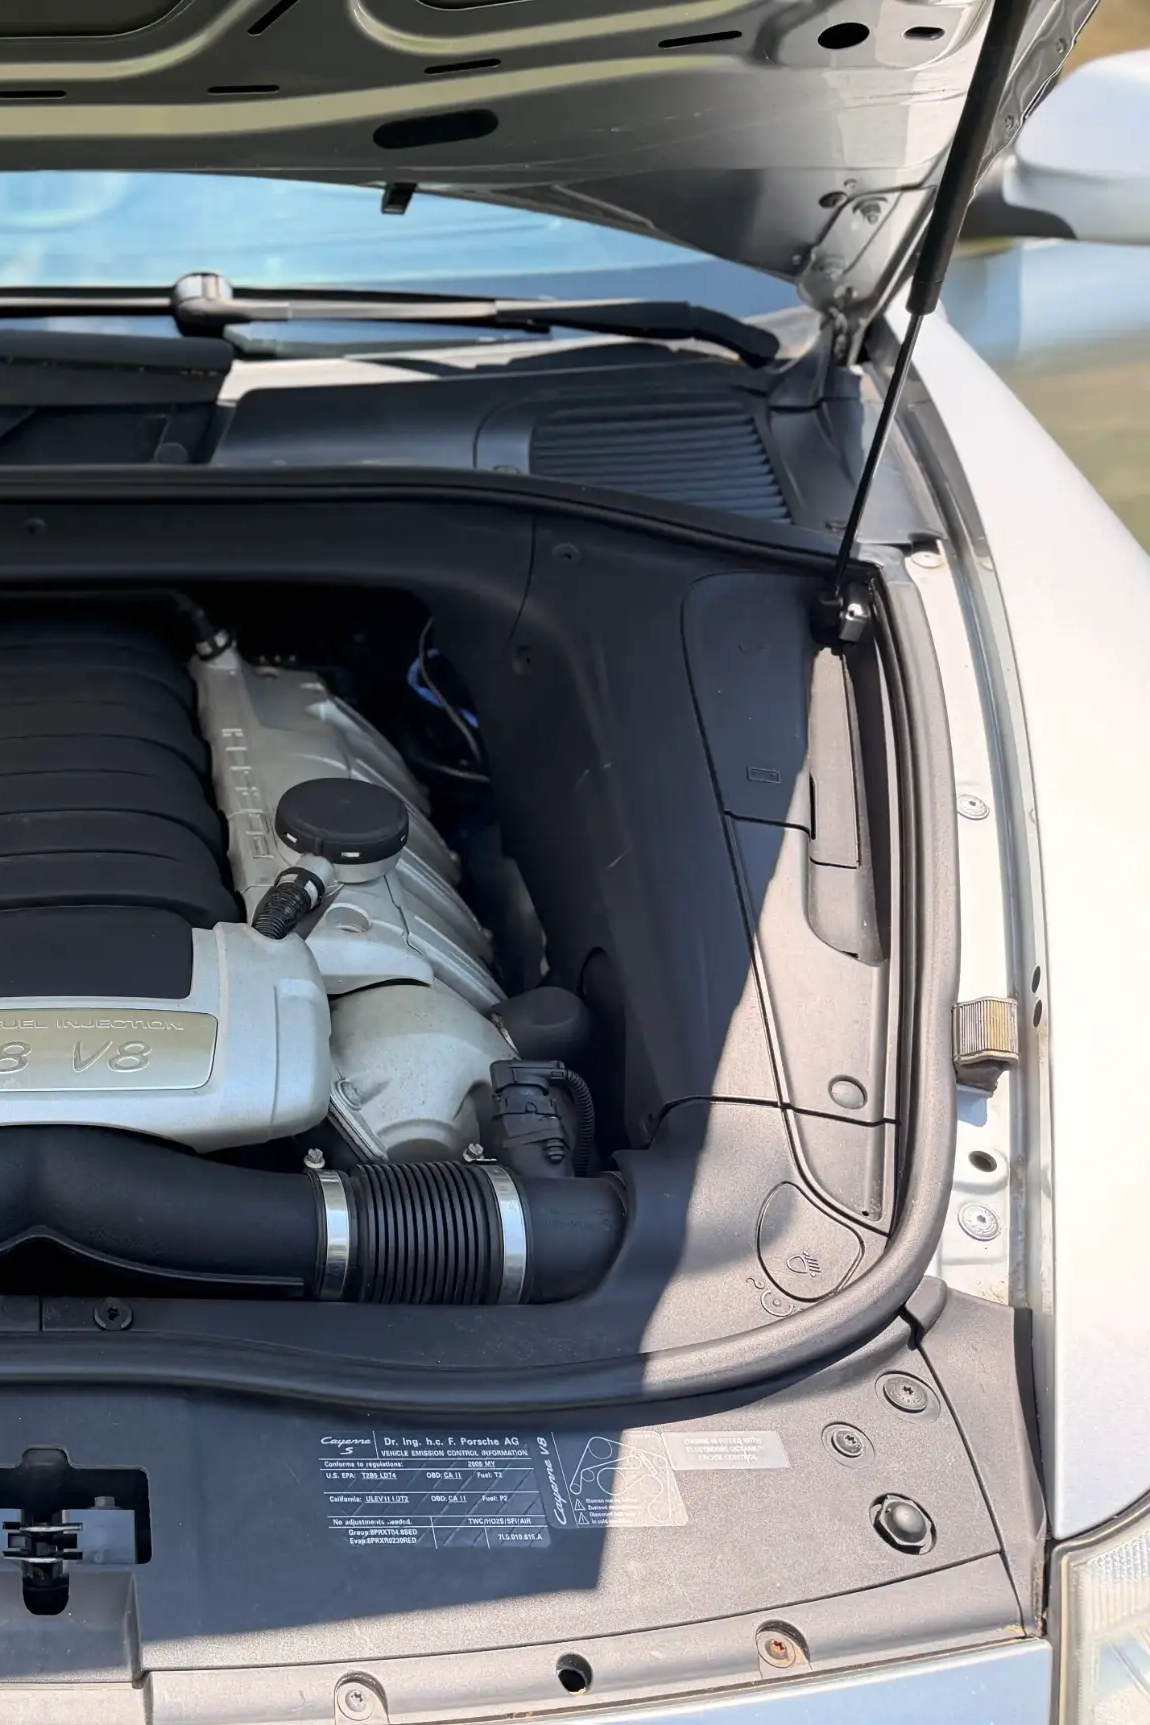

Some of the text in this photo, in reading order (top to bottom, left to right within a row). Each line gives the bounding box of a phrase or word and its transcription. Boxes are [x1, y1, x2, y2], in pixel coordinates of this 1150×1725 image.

[56, 1019, 185, 1031] INJECTION
[72, 1040, 153, 1074] V8
[320, 1436, 371, 1448] Cayenne
[383, 1437, 519, 1447] Dr. Ing. h.c. F. Porsche AG
[340, 1447, 354, 1455] S
[536, 1436, 567, 1525] Cayenne V8
